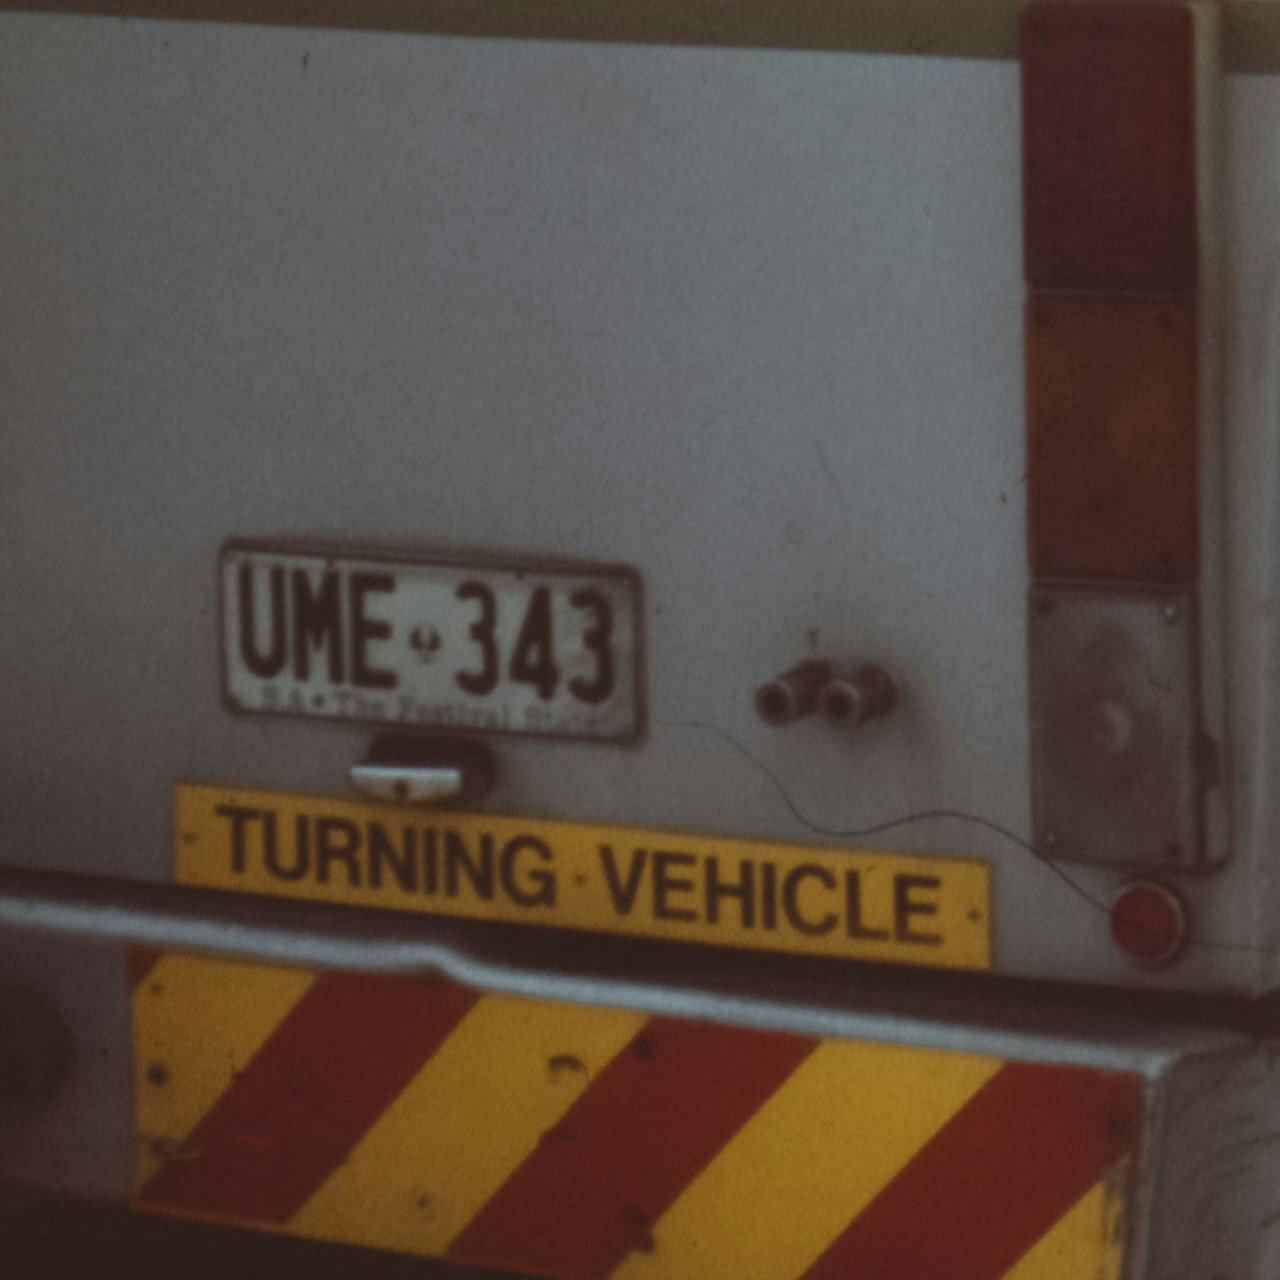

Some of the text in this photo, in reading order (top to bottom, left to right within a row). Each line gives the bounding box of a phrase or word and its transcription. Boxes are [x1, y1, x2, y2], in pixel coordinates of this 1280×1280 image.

[238, 560, 617, 706] UME 343
[216, 804, 945, 948] TURNING VEHICLE
